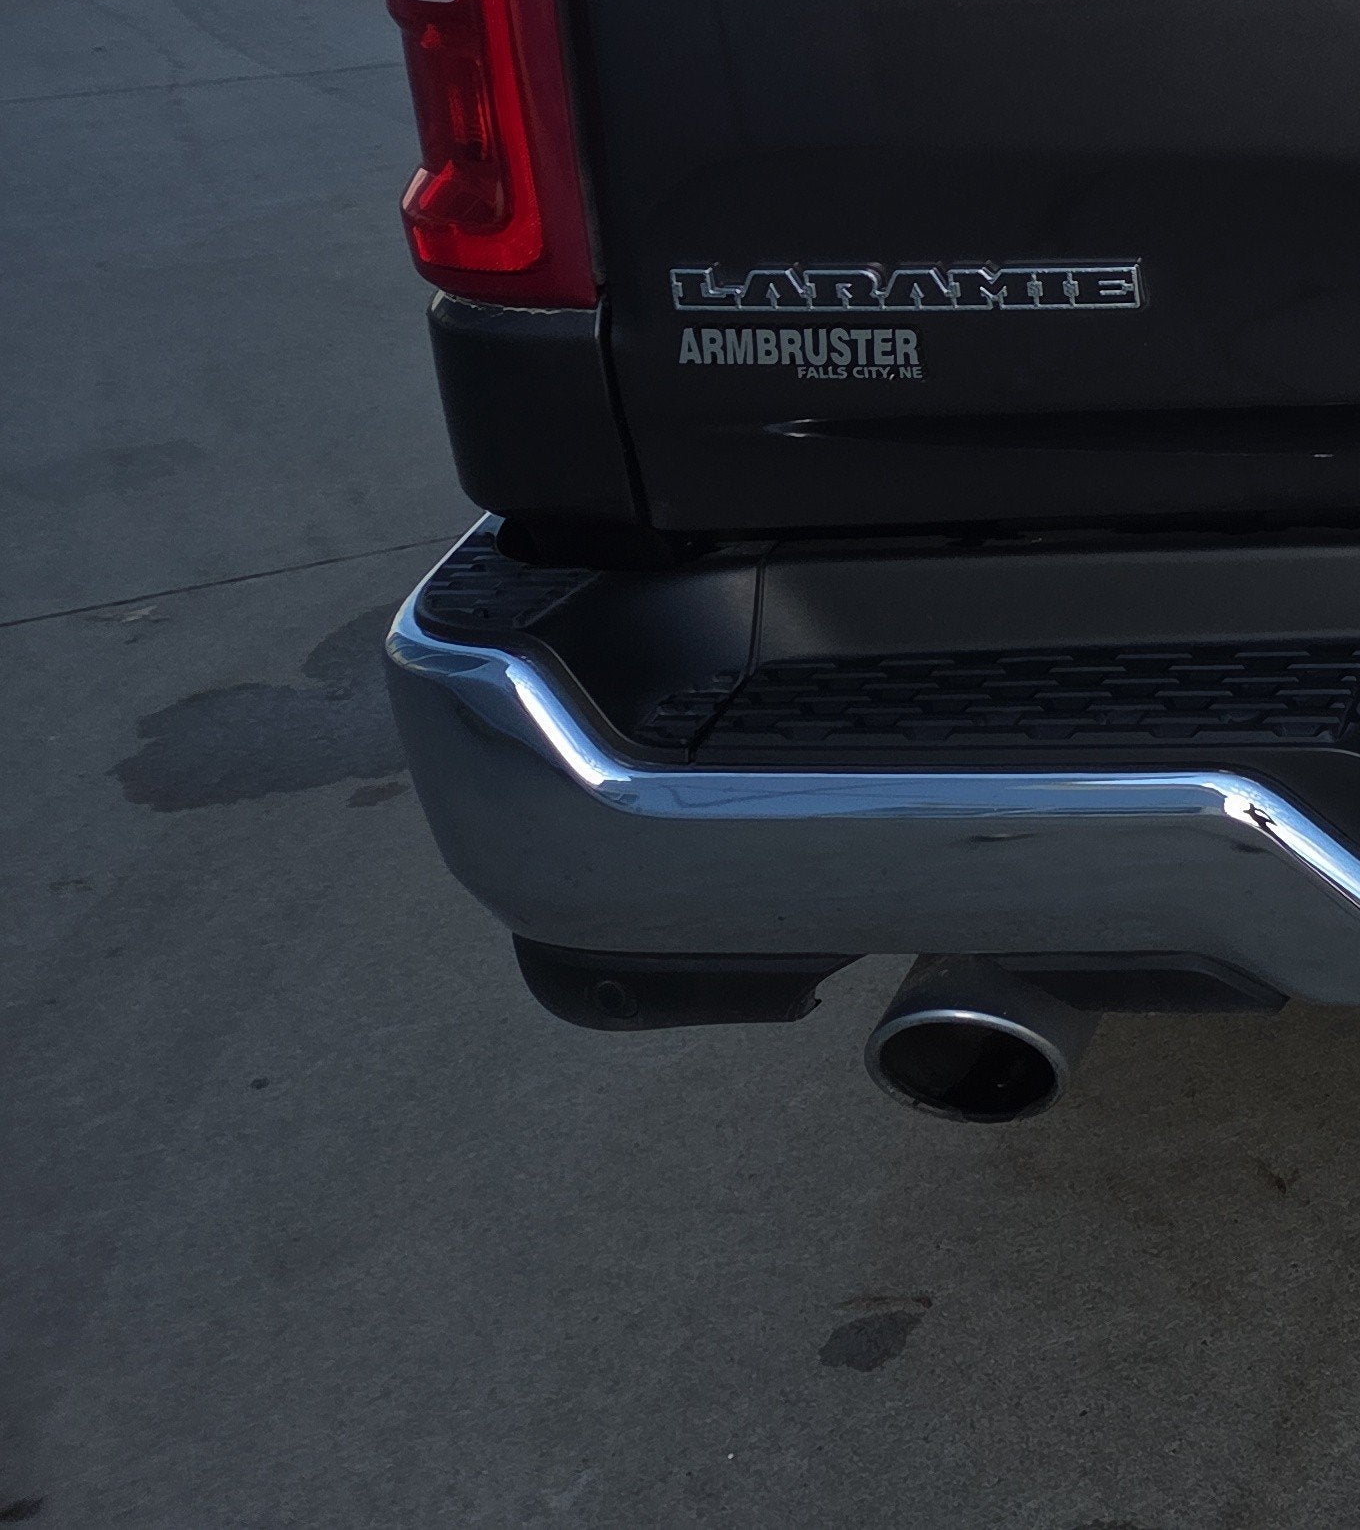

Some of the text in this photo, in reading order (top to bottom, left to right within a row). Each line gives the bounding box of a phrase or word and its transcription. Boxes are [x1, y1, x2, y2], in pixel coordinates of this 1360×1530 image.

[669, 262, 1143, 311] LARAMIE
[678, 327, 921, 366] ARMBRUSTER
[797, 365, 924, 381] FALLS CITY, NE
